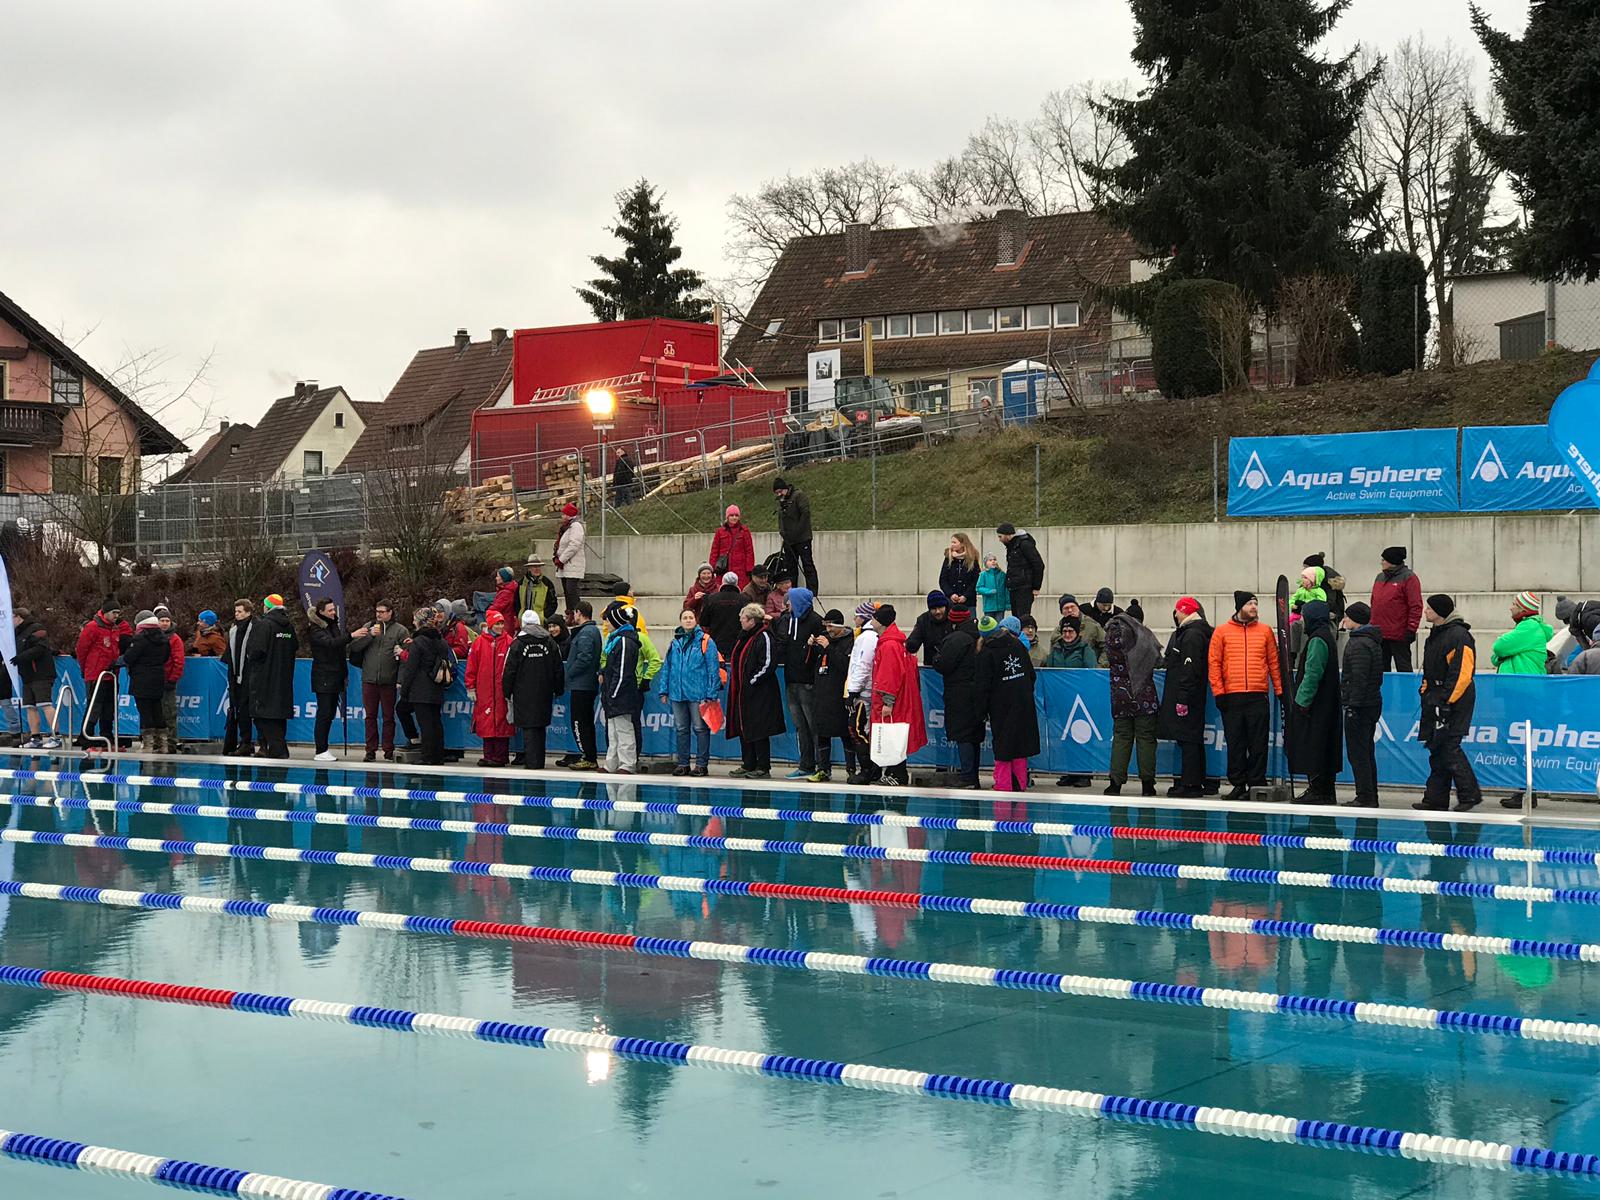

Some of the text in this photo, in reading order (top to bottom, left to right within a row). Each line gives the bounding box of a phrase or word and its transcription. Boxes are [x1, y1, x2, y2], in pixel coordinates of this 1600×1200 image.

[1279, 465, 1443, 490] Aqua Sphere
[1516, 461, 1575, 483] Aqu
[1325, 487, 1443, 501] Active Swim Equipment
[1474, 752, 1518, 767] Active
